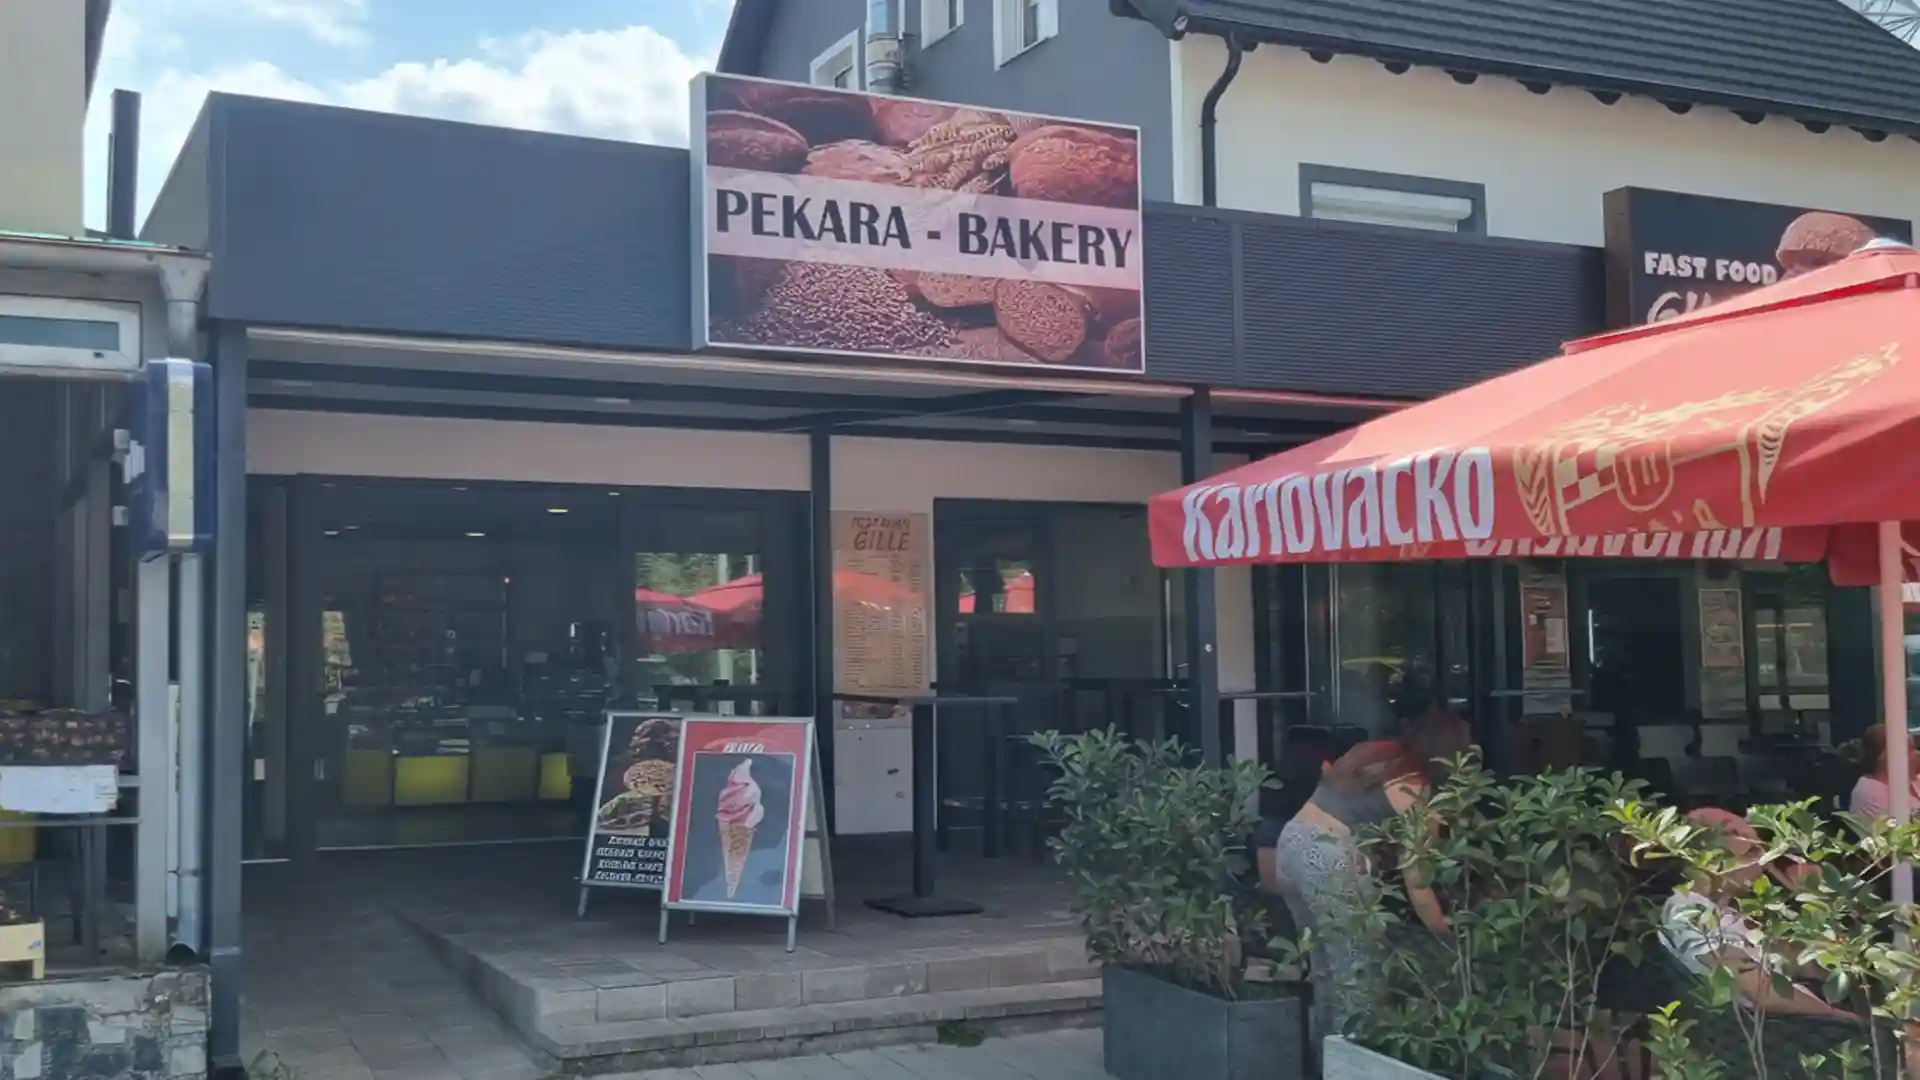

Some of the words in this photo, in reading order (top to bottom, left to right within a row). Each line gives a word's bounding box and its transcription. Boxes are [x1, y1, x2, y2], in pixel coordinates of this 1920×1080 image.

[716, 189, 911, 249] PEKARA
[958, 212, 1132, 268] BAKERY
[1644, 251, 1705, 279] FAST
[1715, 258, 1778, 286] FOOD
[853, 531, 911, 551] GILLE
